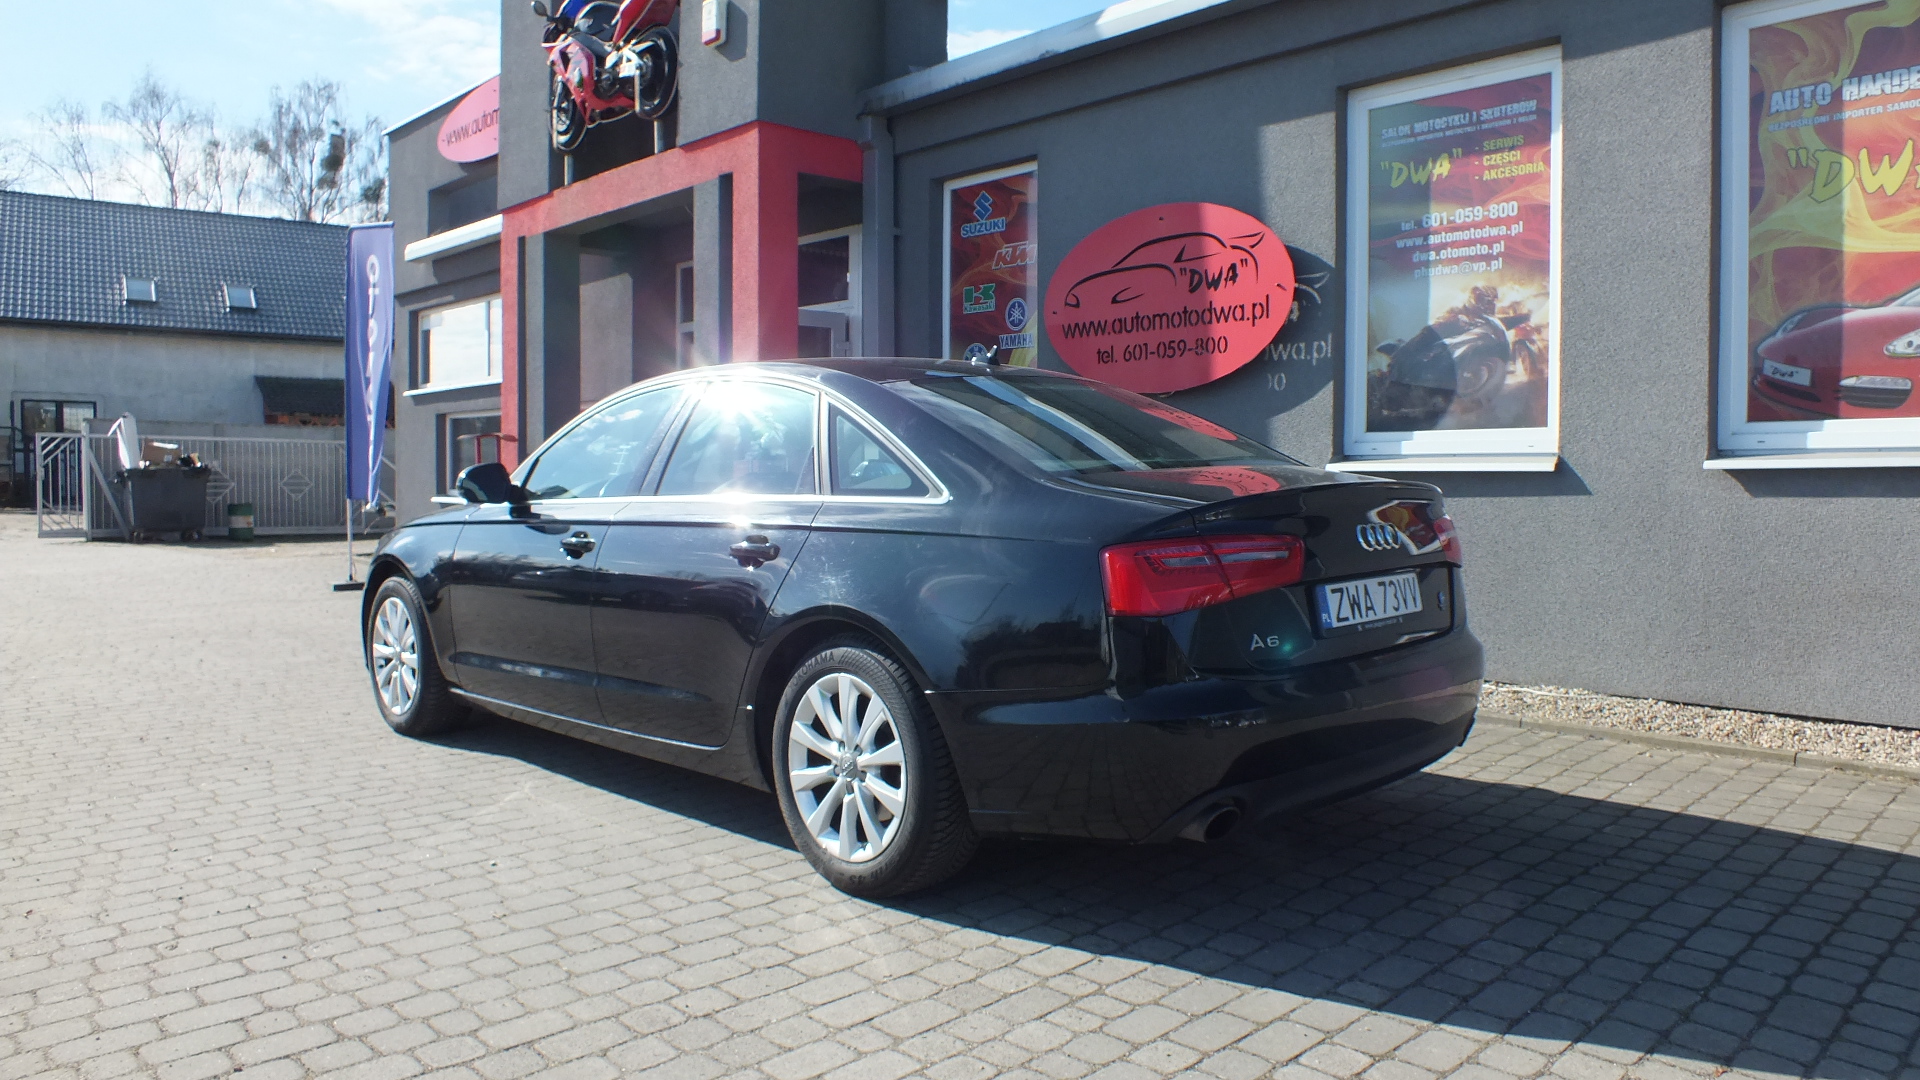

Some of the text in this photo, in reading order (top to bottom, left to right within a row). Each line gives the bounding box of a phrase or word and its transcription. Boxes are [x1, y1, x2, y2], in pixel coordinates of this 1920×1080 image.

[1769, 82, 1832, 116] AUTO
[1833, 105, 1883, 121] IMPORTER
[1483, 135, 1525, 152] SERWIS
[1381, 147, 1463, 188] "DWA"
[1483, 149, 1521, 167] CZĘŚCI
[1787, 137, 1920, 204] "DW
[1483, 161, 1545, 181] AKCESORIA
[962, 218, 1006, 237] SUZUKI
[1401, 201, 1518, 231] tel. 601-059-800
[1396, 221, 1523, 248] www.automotodwa.pl
[992, 241, 1037, 269] KTM
[1412, 240, 1505, 263] dwa.otomoto.pl
[1180, 258, 1248, 294] "DWA"
[1414, 258, 1503, 279] phudwa@vp.pl
[1062, 294, 1270, 339] www.automotodwa.pl
[1000, 333, 1034, 349] YAMAHA
[1097, 335, 1229, 365] tel. 601-059-800
[1330, 577, 1418, 624] ZWA 73VV
[1322, 613, 1331, 623] PL
[1250, 633, 1280, 651] A6
